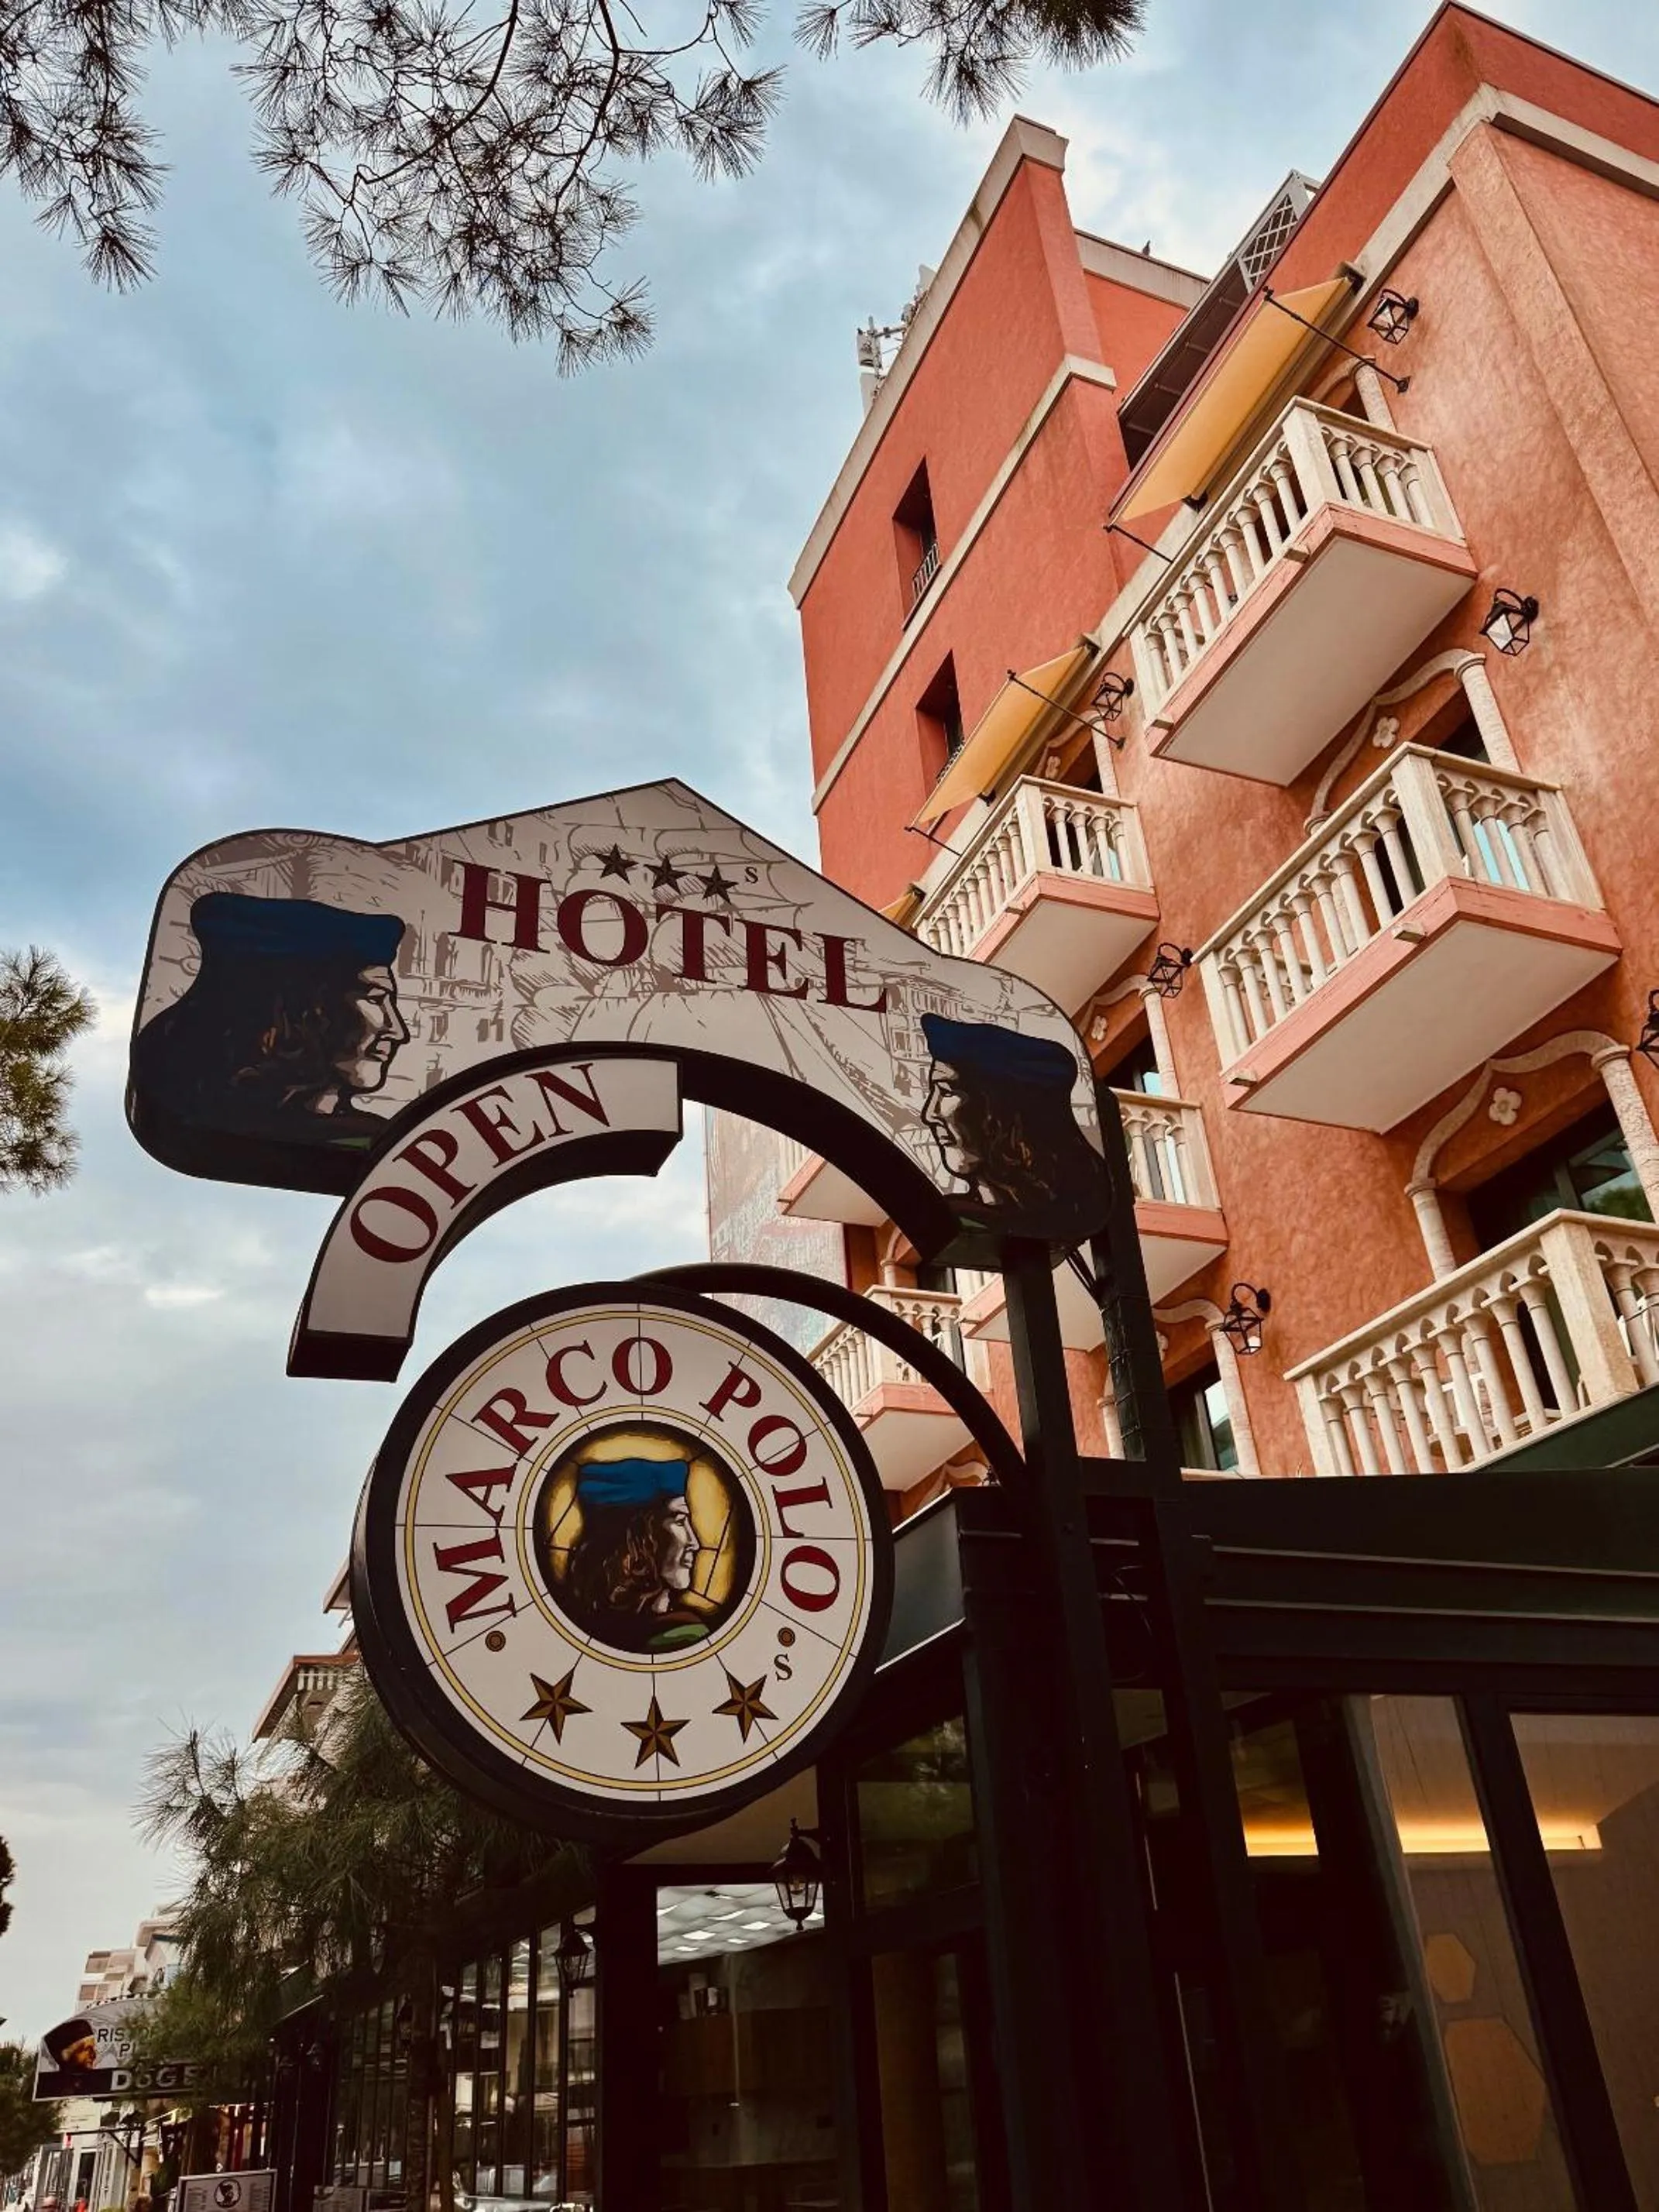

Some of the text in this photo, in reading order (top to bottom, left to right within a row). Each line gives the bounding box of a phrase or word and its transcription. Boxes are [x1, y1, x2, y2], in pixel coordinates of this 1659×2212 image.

[448, 859, 888, 1014] HOTEL
[744, 866, 759, 884] S
[349, 1063, 611, 1264] OPEN
[433, 1336, 841, 1633] MARCO POLO
[773, 1653, 793, 1681] S
